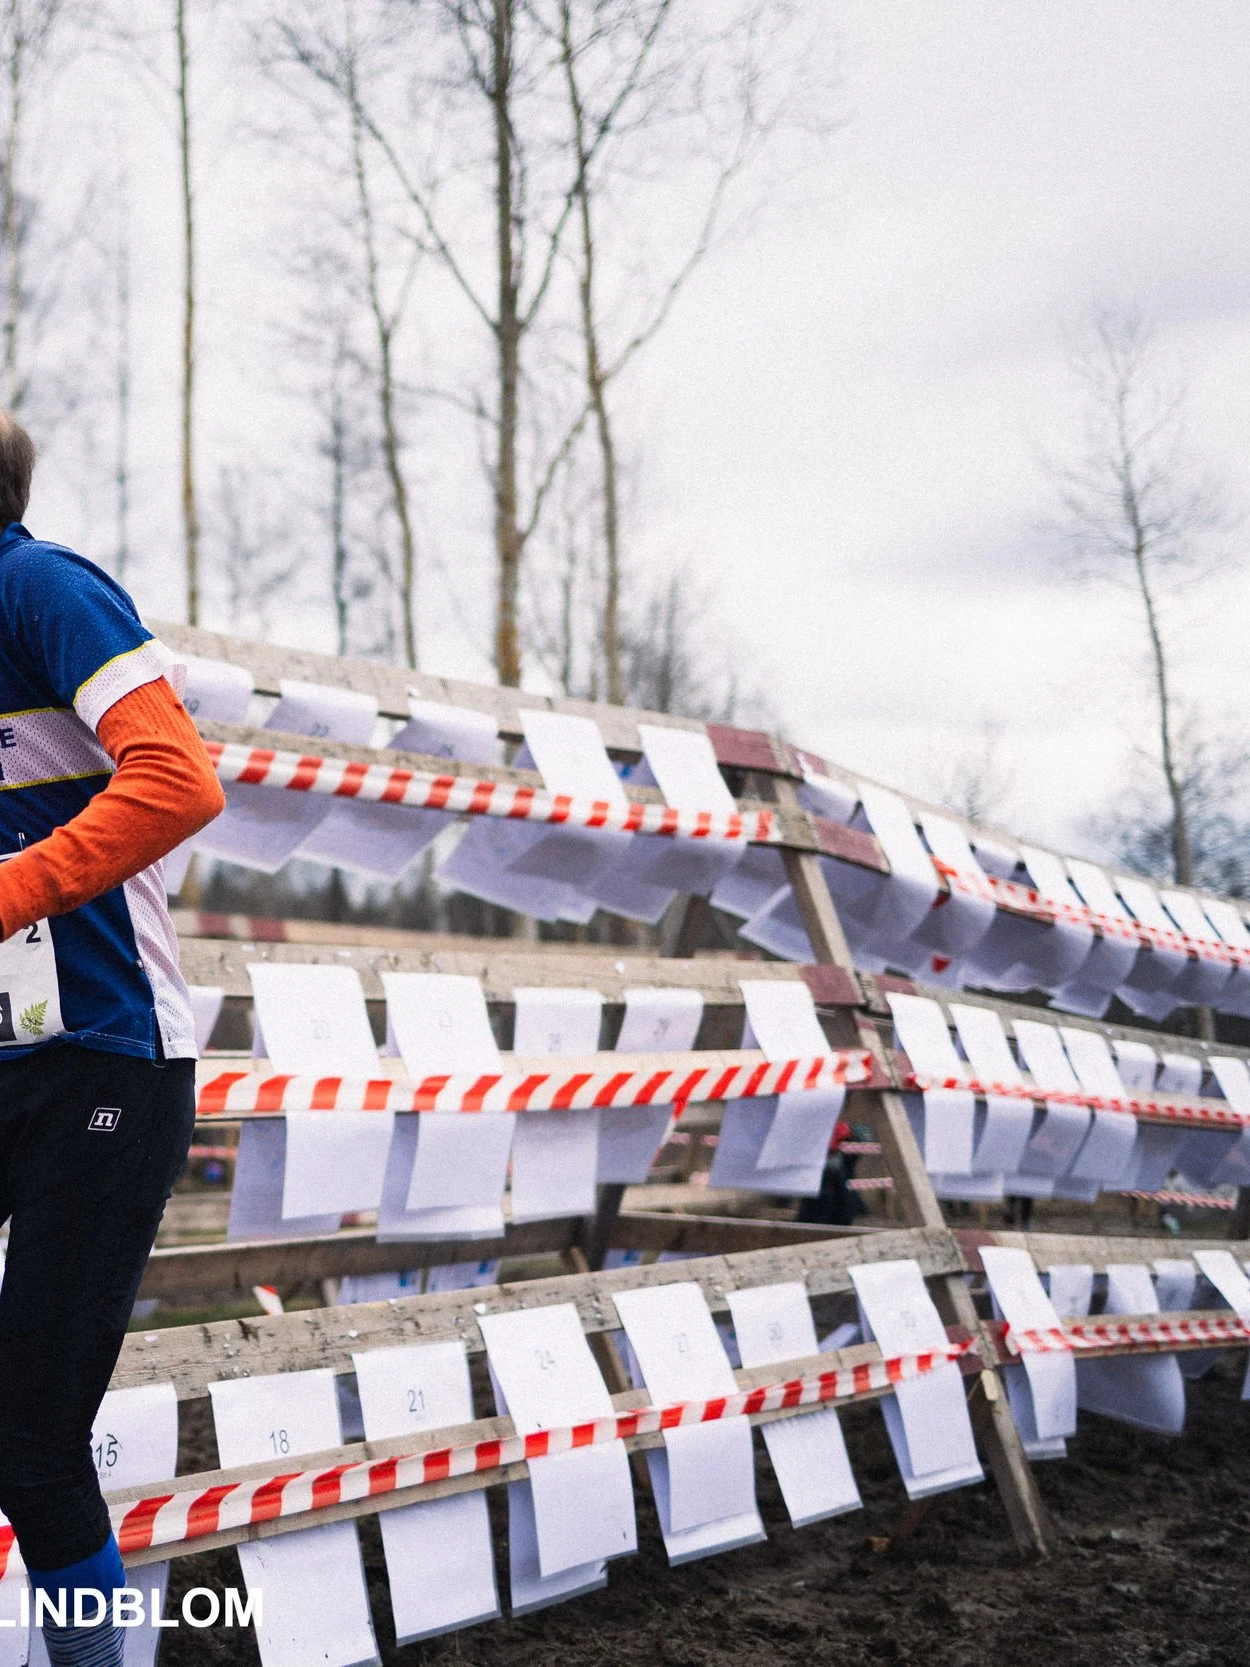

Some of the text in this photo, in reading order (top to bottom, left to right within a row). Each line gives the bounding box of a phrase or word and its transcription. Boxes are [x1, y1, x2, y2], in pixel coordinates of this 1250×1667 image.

[22, 921, 42, 944] 2
[406, 1388, 425, 1413] 21
[95, 1441, 118, 1468] 15
[270, 1429, 290, 1455] 18
